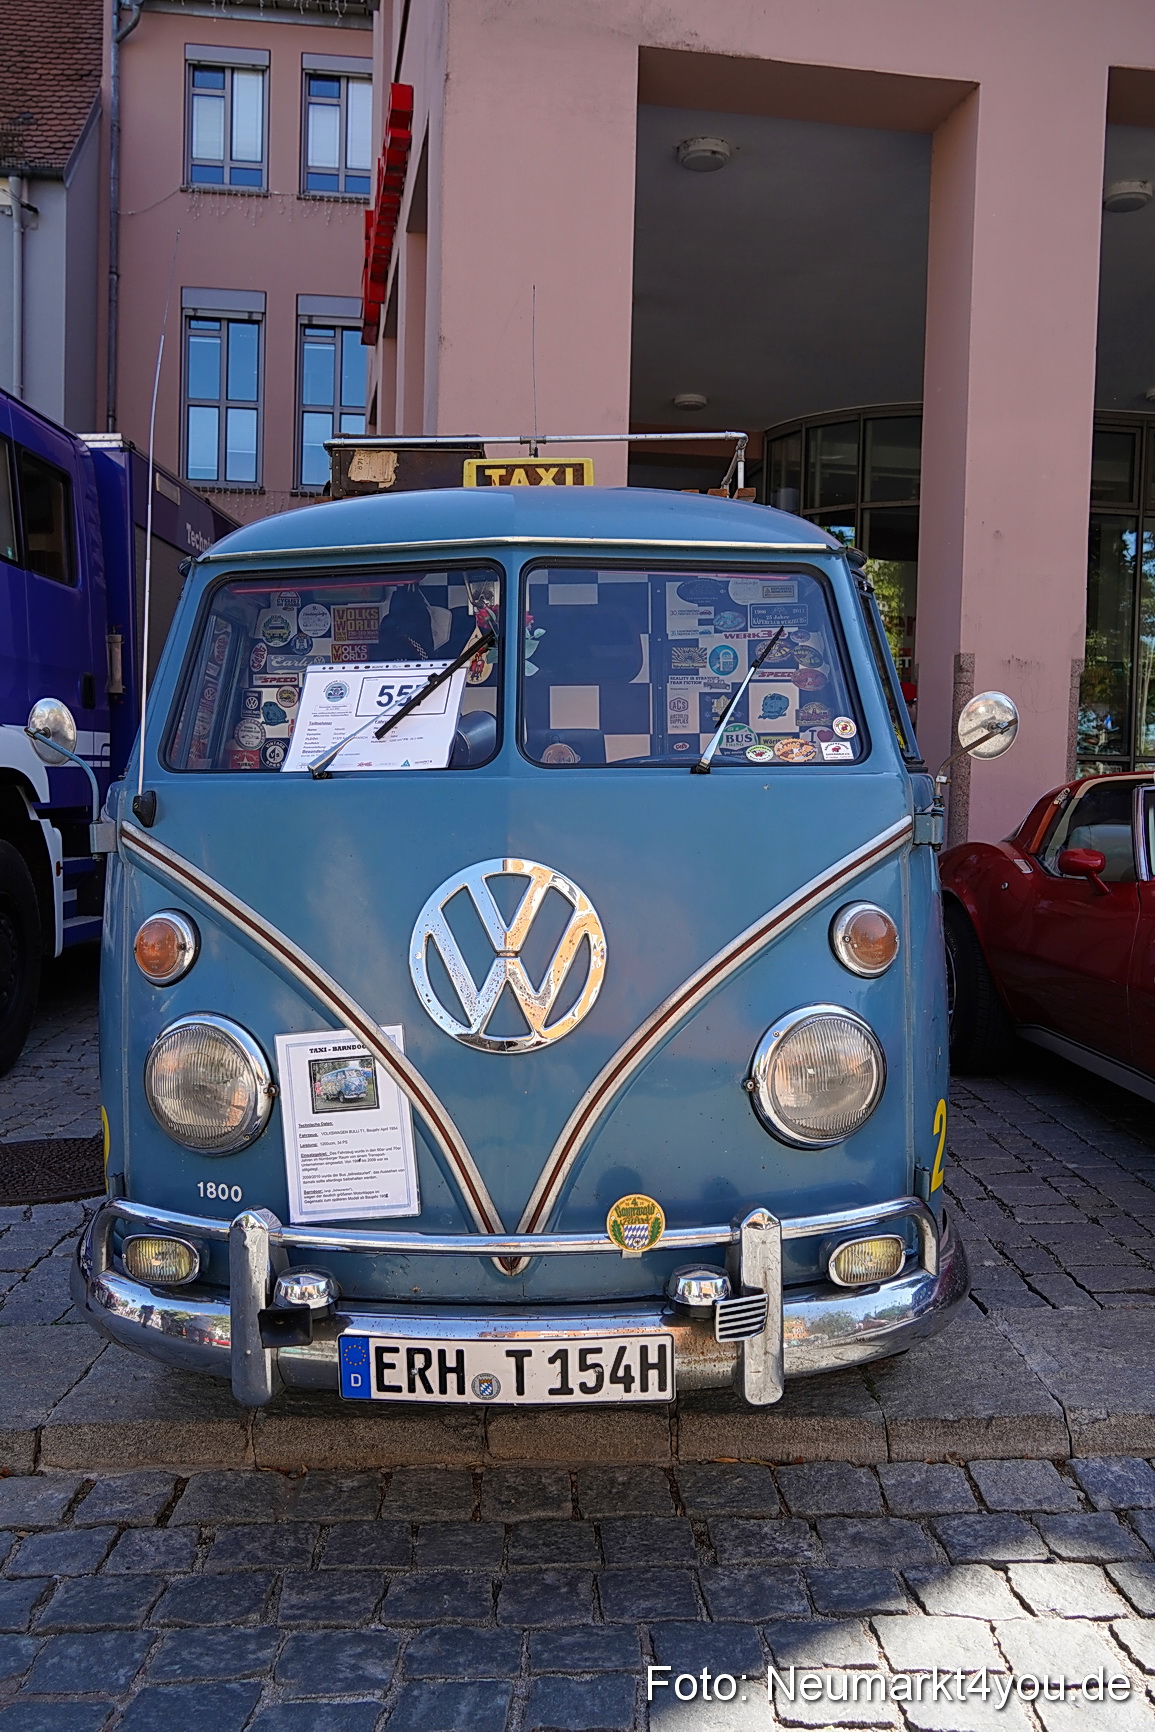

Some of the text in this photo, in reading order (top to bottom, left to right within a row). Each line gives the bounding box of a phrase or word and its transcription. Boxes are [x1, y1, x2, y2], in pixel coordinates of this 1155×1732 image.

[485, 467, 573, 486] TAXI
[186, 522, 213, 552] Techni
[335, 608, 379, 620] VOLKS
[335, 620, 379, 631] WORLD
[333, 644, 368, 653] VOLKS
[333, 653, 368, 662] WORLD
[376, 684, 424, 707] 55
[725, 734, 753, 743] BUS
[332, 1044, 367, 1052] BARNDOO
[930, 1098, 947, 1193] 2
[197, 1181, 243, 1203] 1800
[375, 1343, 667, 1396] ERH T 154H
[351, 1373, 362, 1387] D
